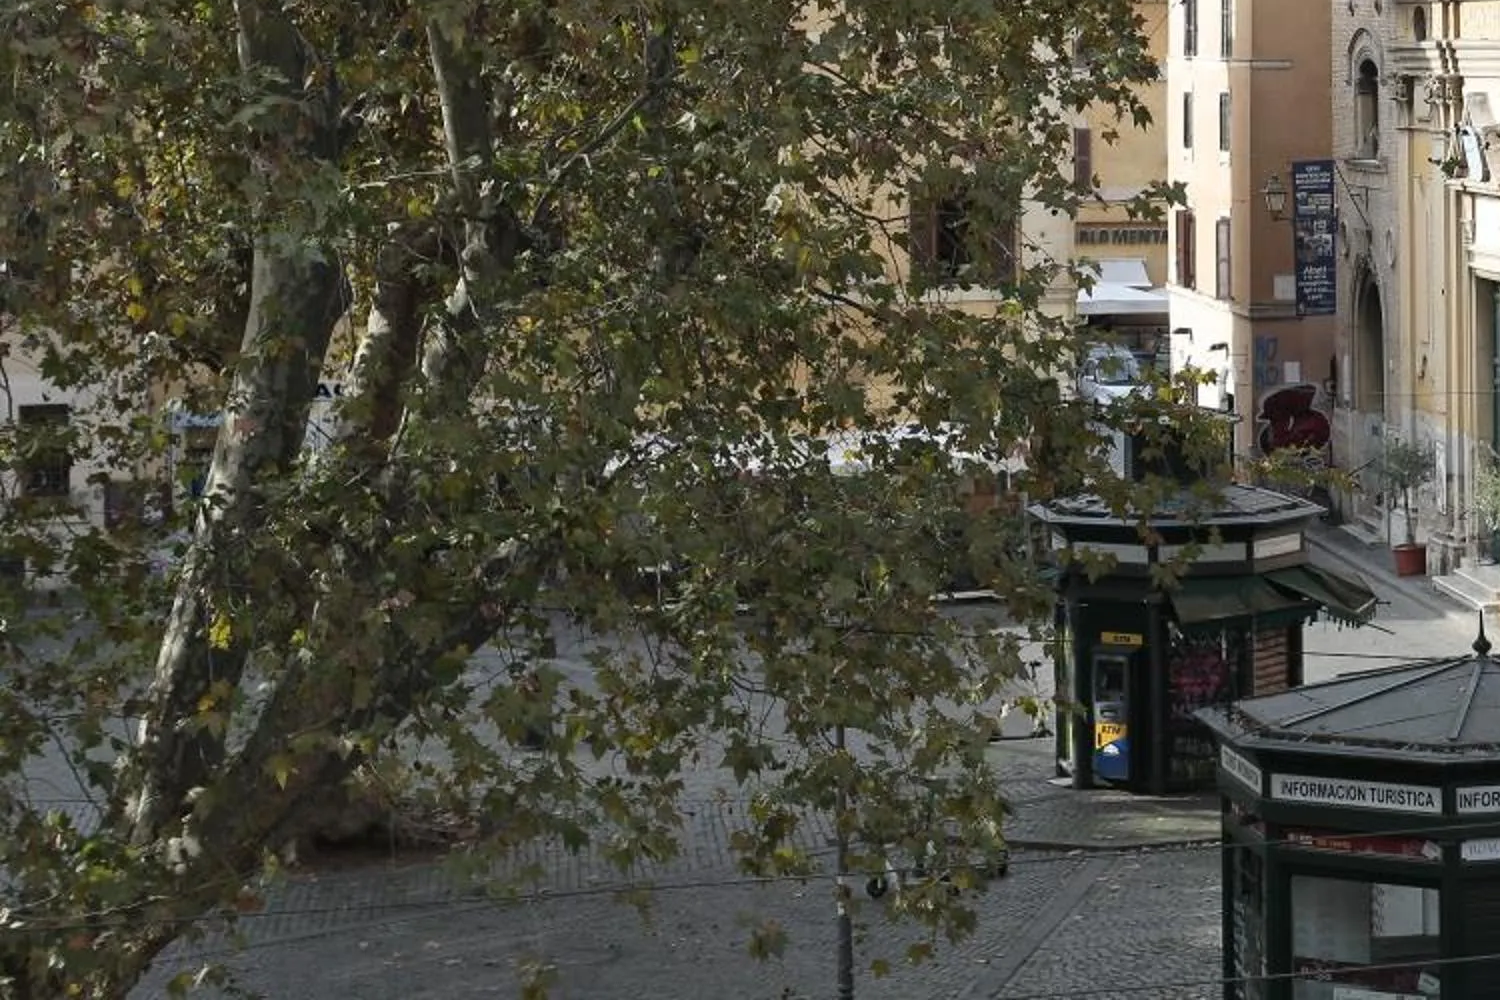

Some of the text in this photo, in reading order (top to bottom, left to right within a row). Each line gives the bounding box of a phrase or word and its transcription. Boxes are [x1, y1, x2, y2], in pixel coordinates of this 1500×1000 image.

[1101, 725, 1121, 734] ATM
[1280, 780, 1435, 808] INFORMACION TURISTICA
